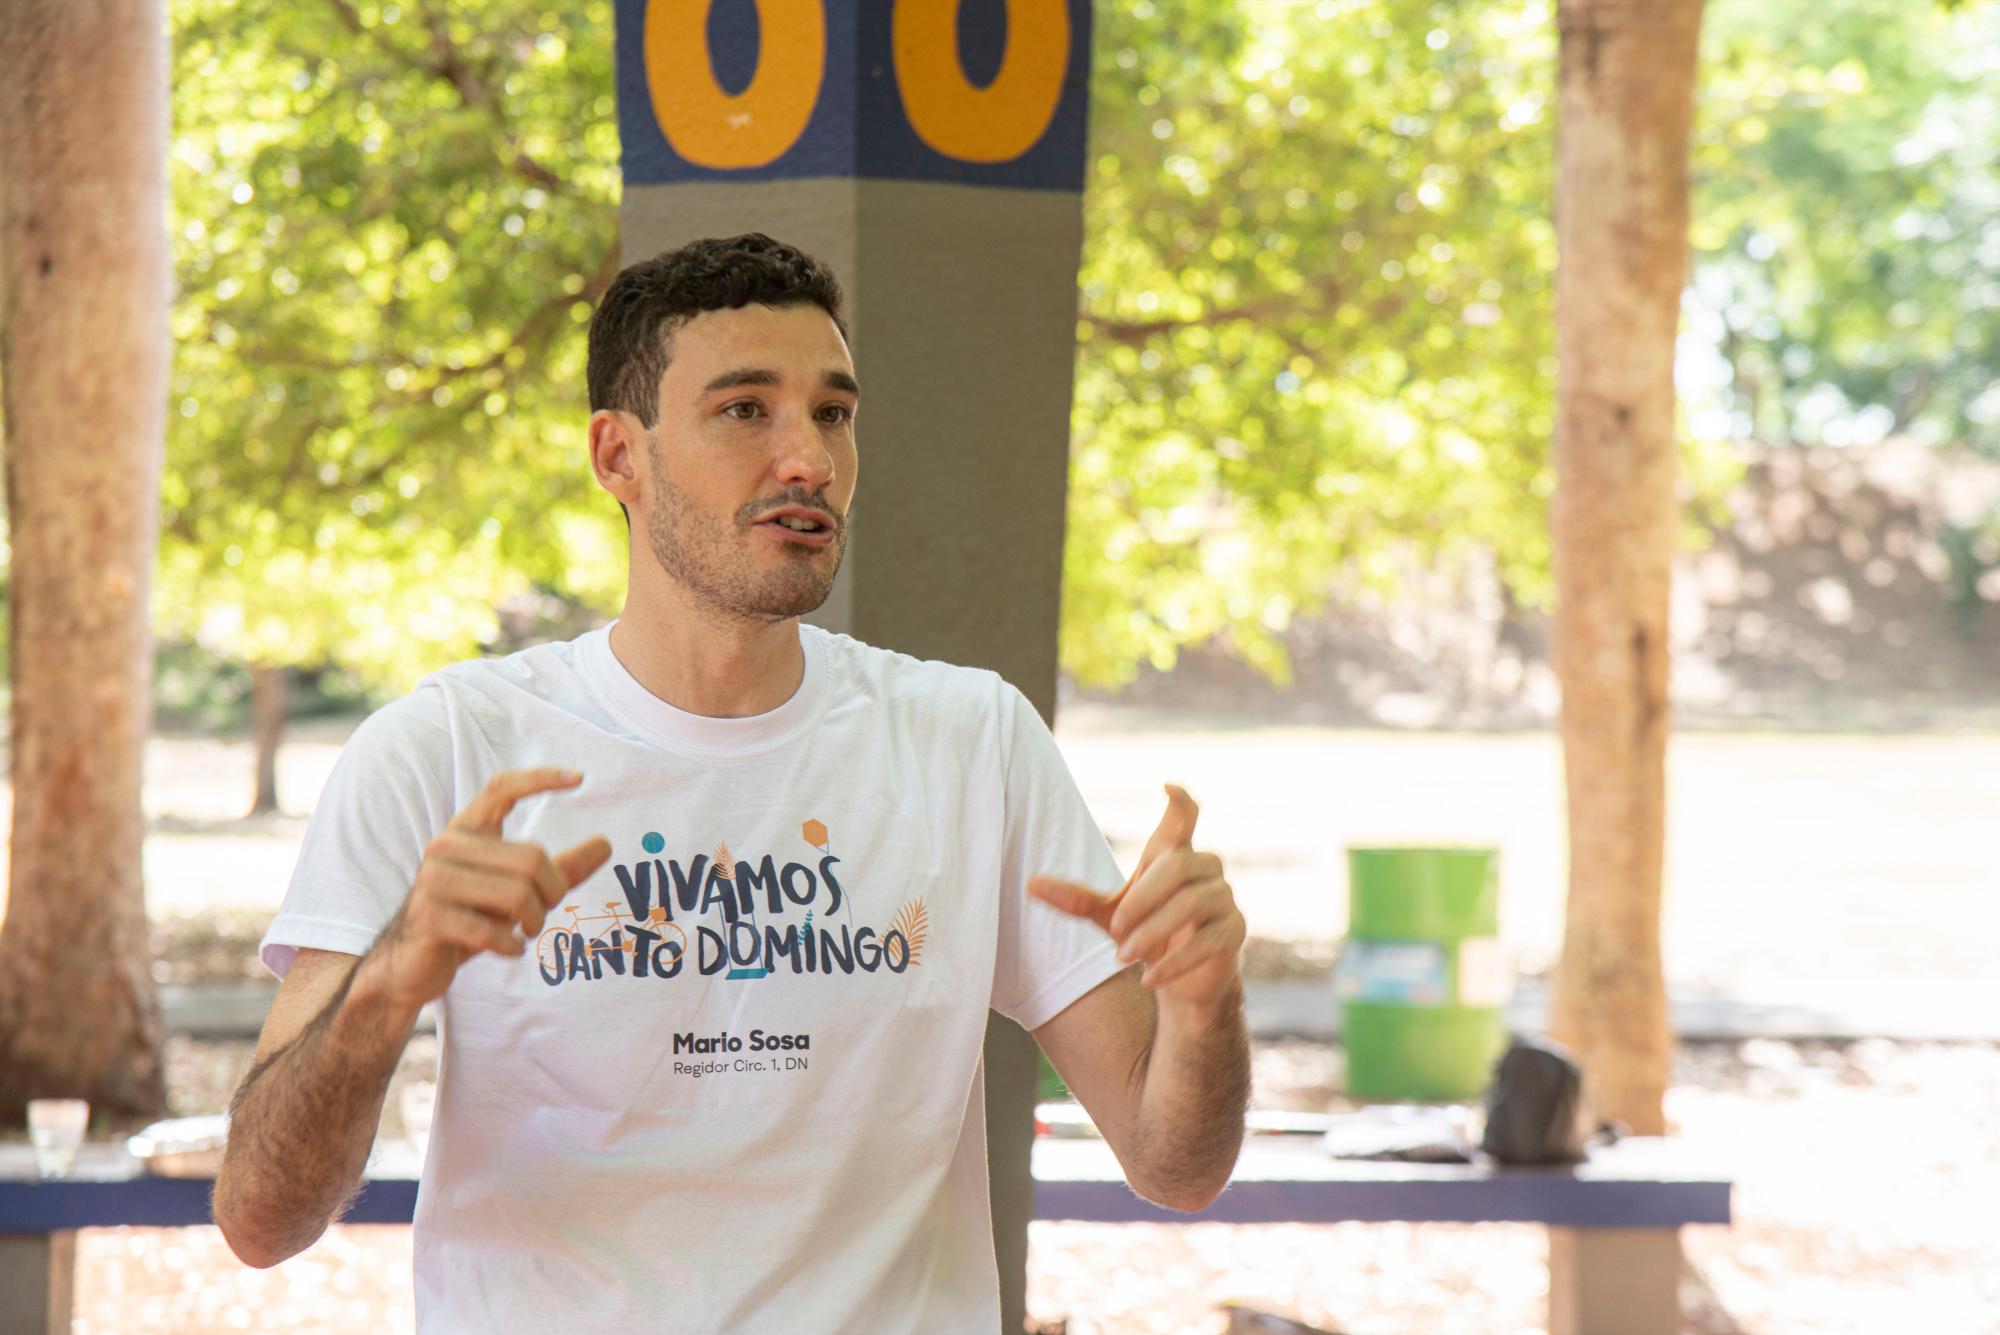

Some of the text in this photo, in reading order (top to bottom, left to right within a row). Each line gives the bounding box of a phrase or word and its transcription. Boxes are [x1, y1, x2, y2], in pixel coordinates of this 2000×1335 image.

[613, 854, 841, 923] VIVAMOS
[540, 922, 911, 986] SANTO DOMINGO
[673, 1030, 810, 1054] Mario Sosa
[673, 1057, 808, 1077] Regidor Circ. 1, DN
